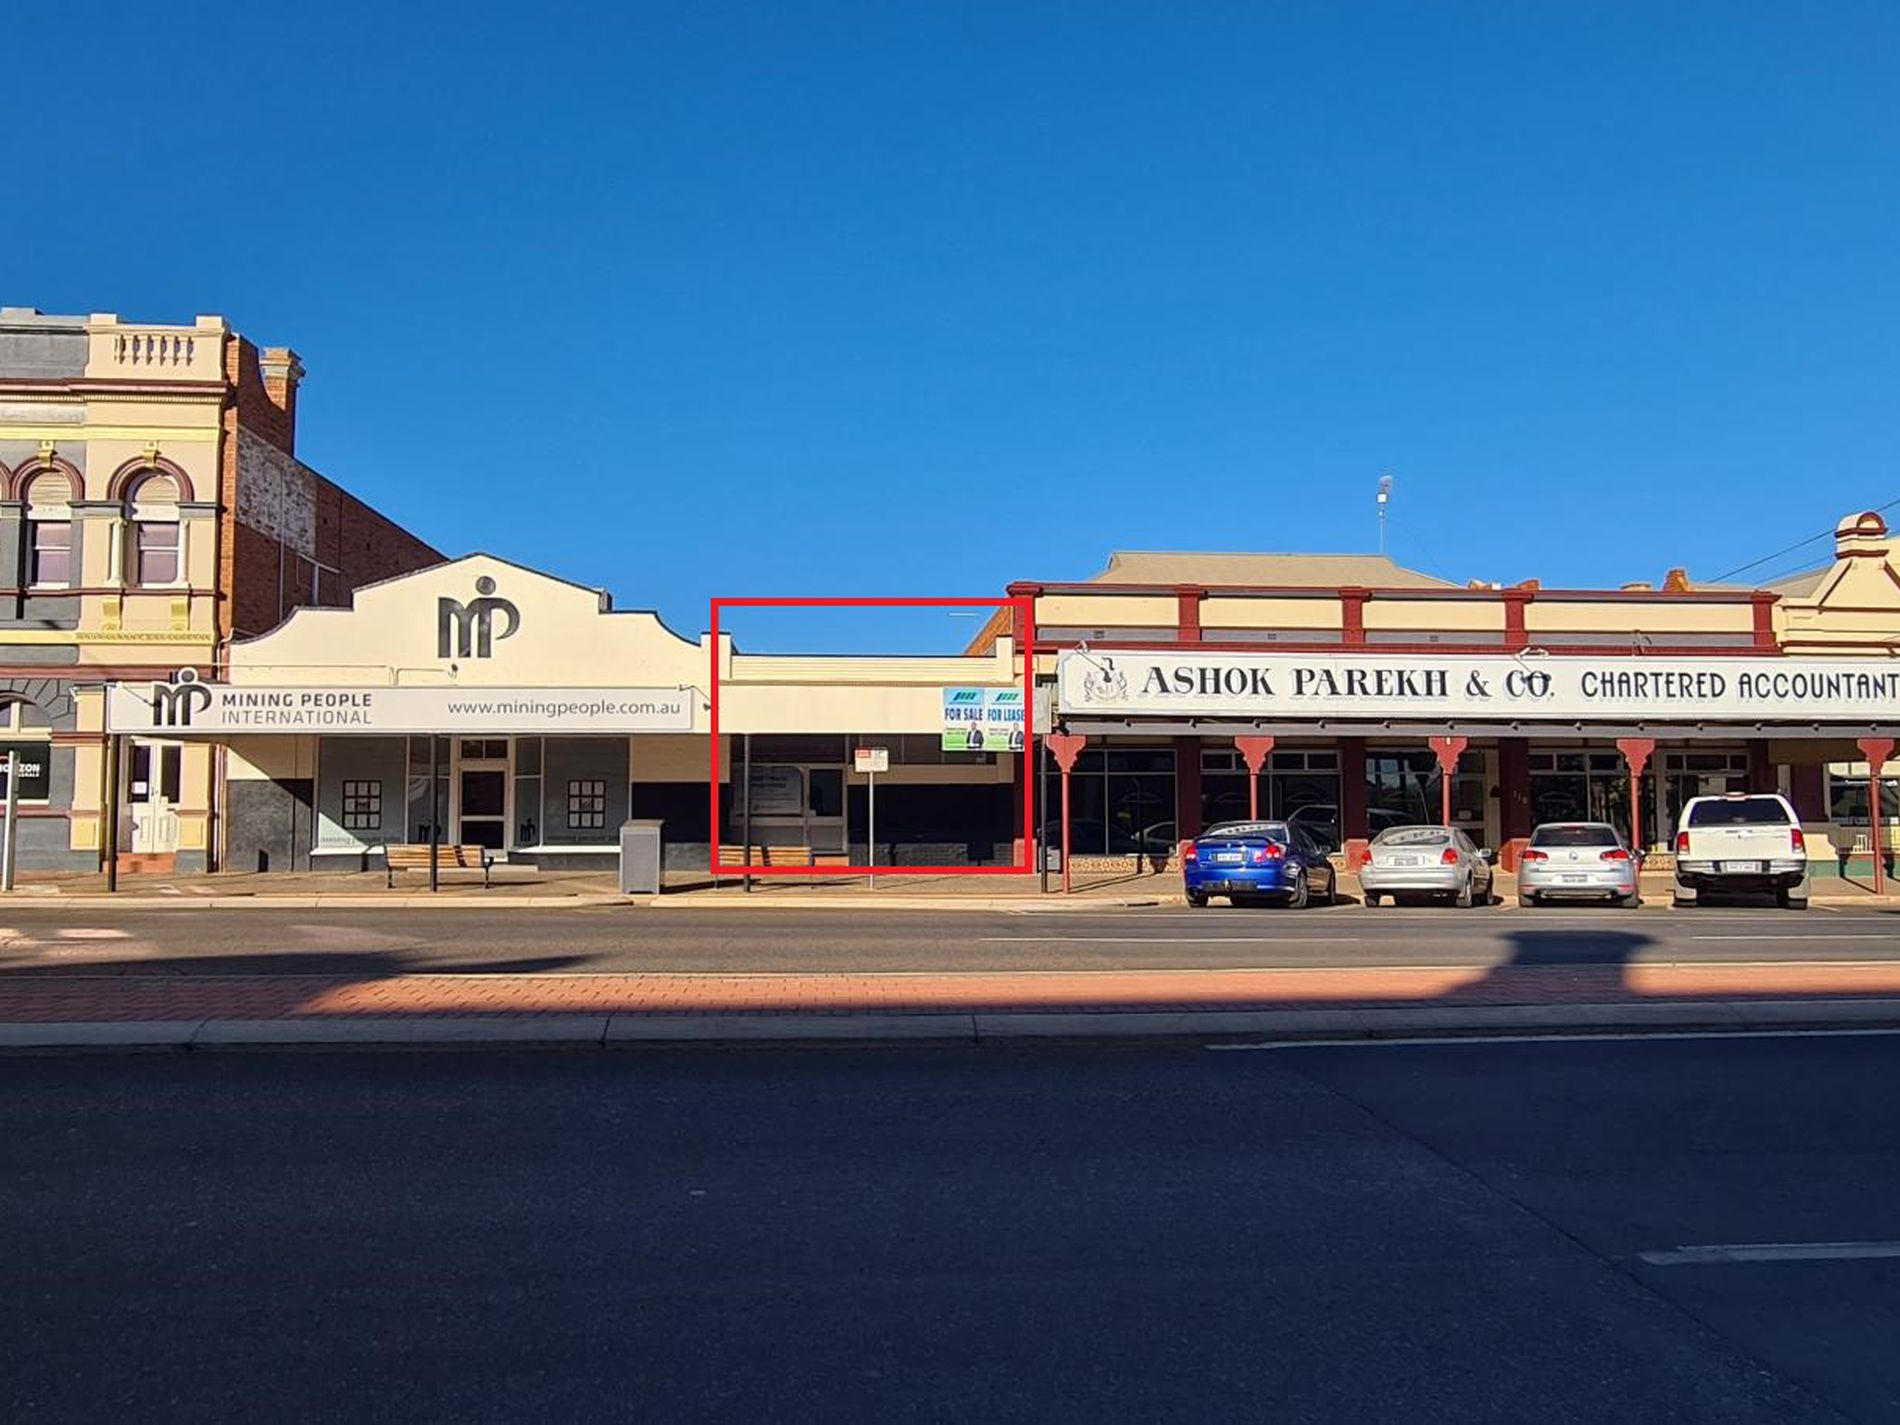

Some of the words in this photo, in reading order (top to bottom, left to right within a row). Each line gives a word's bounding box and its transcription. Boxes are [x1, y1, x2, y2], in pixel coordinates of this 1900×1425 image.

[1142, 666, 1275, 695] ASHOK
[1292, 668, 1449, 697] PAREKH
[1465, 670, 1492, 698] &
[1506, 670, 1555, 698] CO.
[1581, 671, 1726, 698] CHARTERED
[1738, 672, 1899, 699] ACCOUNTANT
[222, 693, 293, 707] MINING
[301, 693, 372, 707] PEOPLE
[448, 699, 681, 718] www.miningpeople.com.au
[945, 708, 961, 720] FOR
[964, 708, 983, 720] SALE
[988, 709, 1002, 721] FOR
[222, 710, 372, 725] INTERNATIONAL
